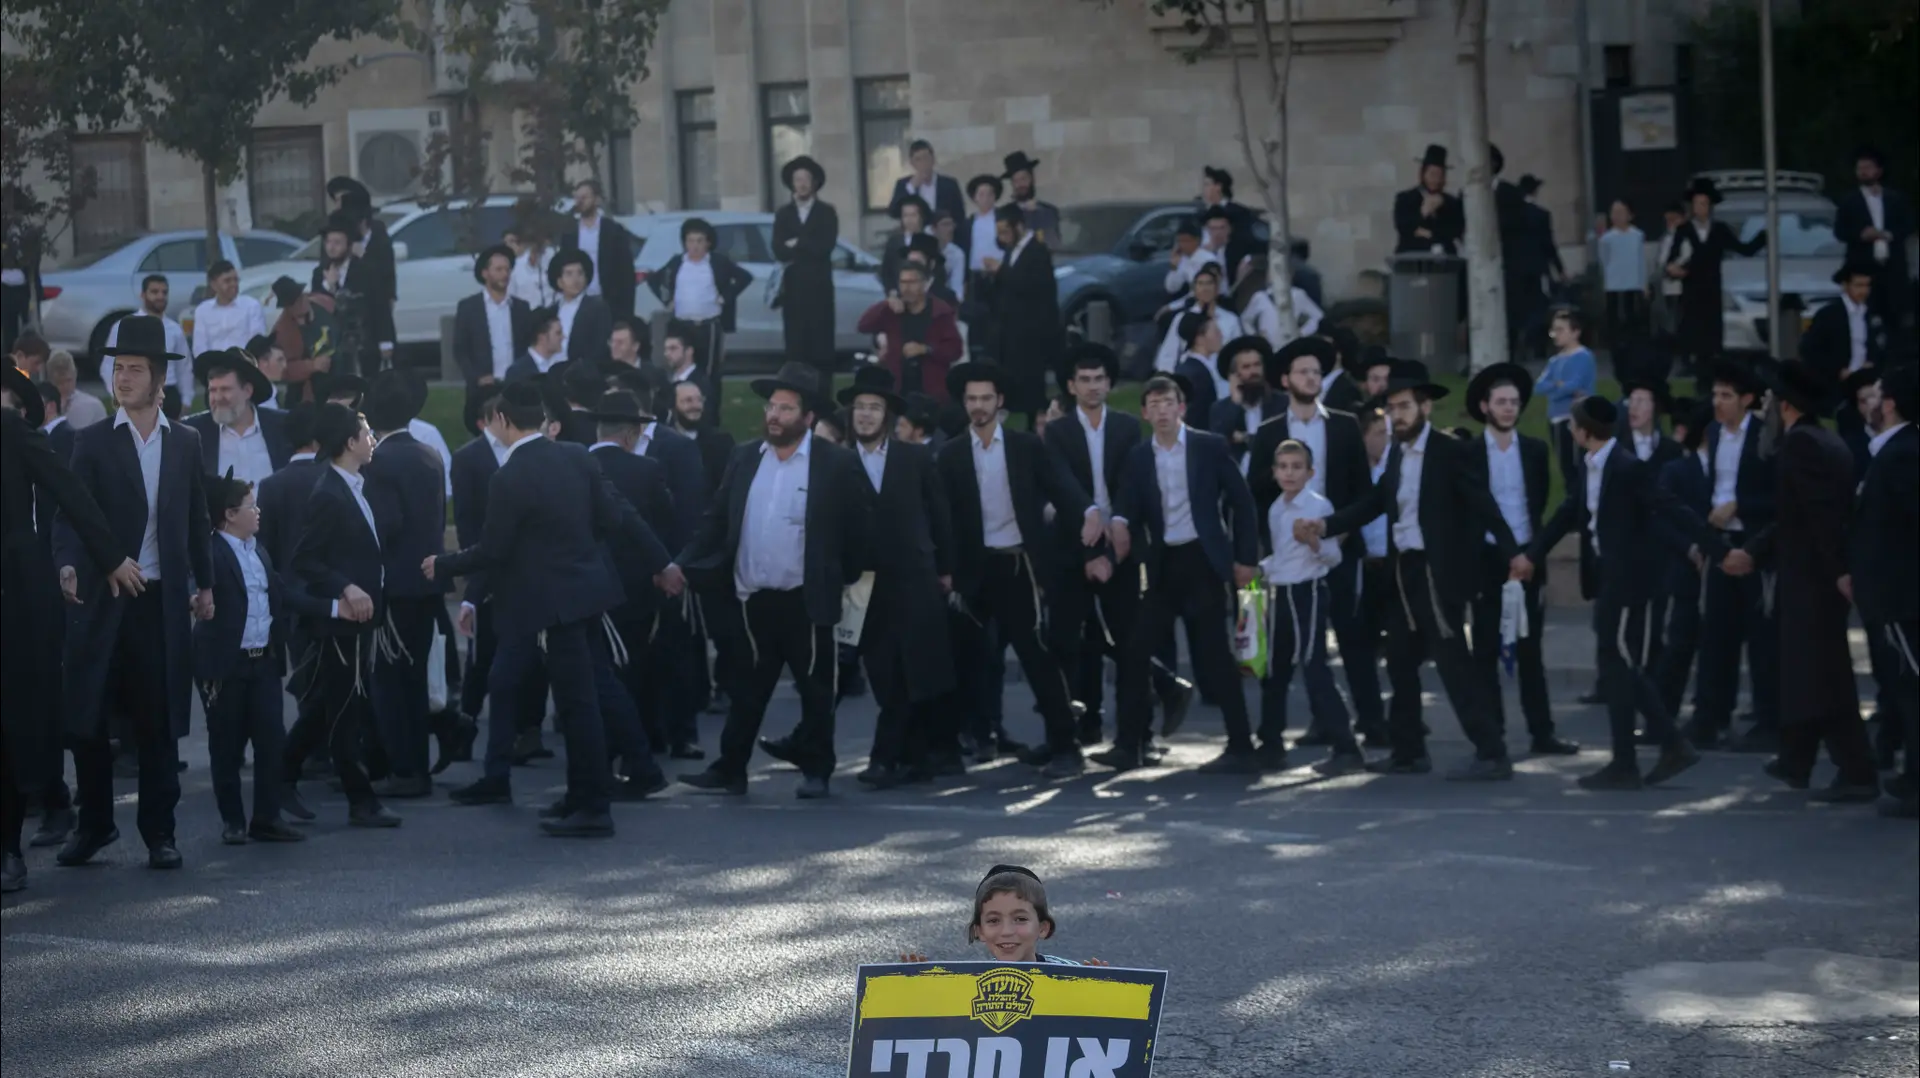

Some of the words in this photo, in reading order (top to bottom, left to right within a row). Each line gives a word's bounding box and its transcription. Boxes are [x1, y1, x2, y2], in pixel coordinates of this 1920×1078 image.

[988, 993, 1018, 1002] להצלת
[976, 1002, 1004, 1012] התורה
[1005, 1001, 1028, 1012] עולם
[870, 1037, 1022, 1078] חרדי
